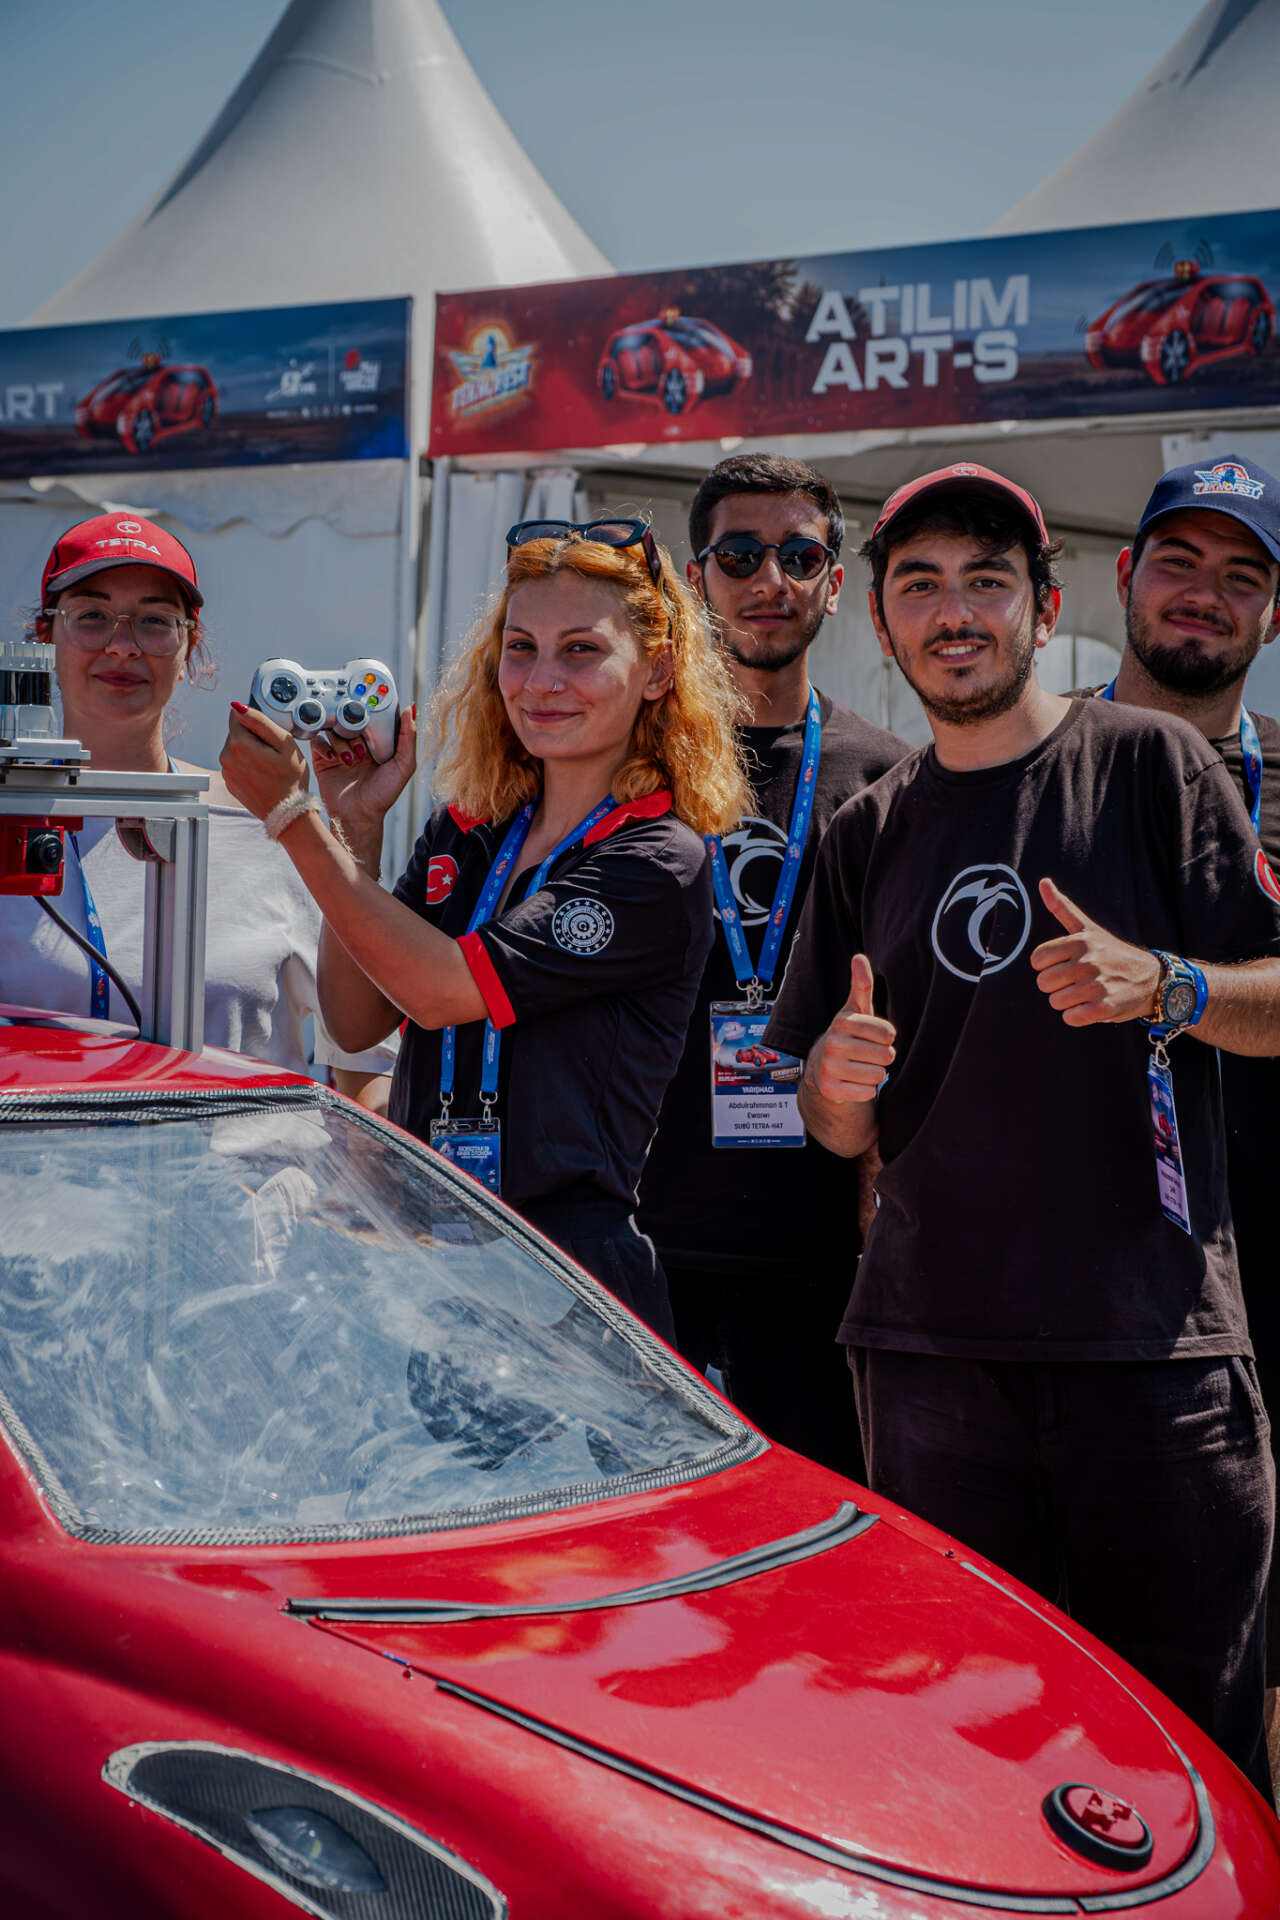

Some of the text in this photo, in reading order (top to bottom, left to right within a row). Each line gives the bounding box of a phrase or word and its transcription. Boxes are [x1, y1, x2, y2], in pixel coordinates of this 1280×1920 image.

[805, 274, 1029, 342] ATILIM
[812, 329, 1019, 394] ART-S
[0, 382, 64, 420] RT
[96, 538, 161, 556] TETRA
